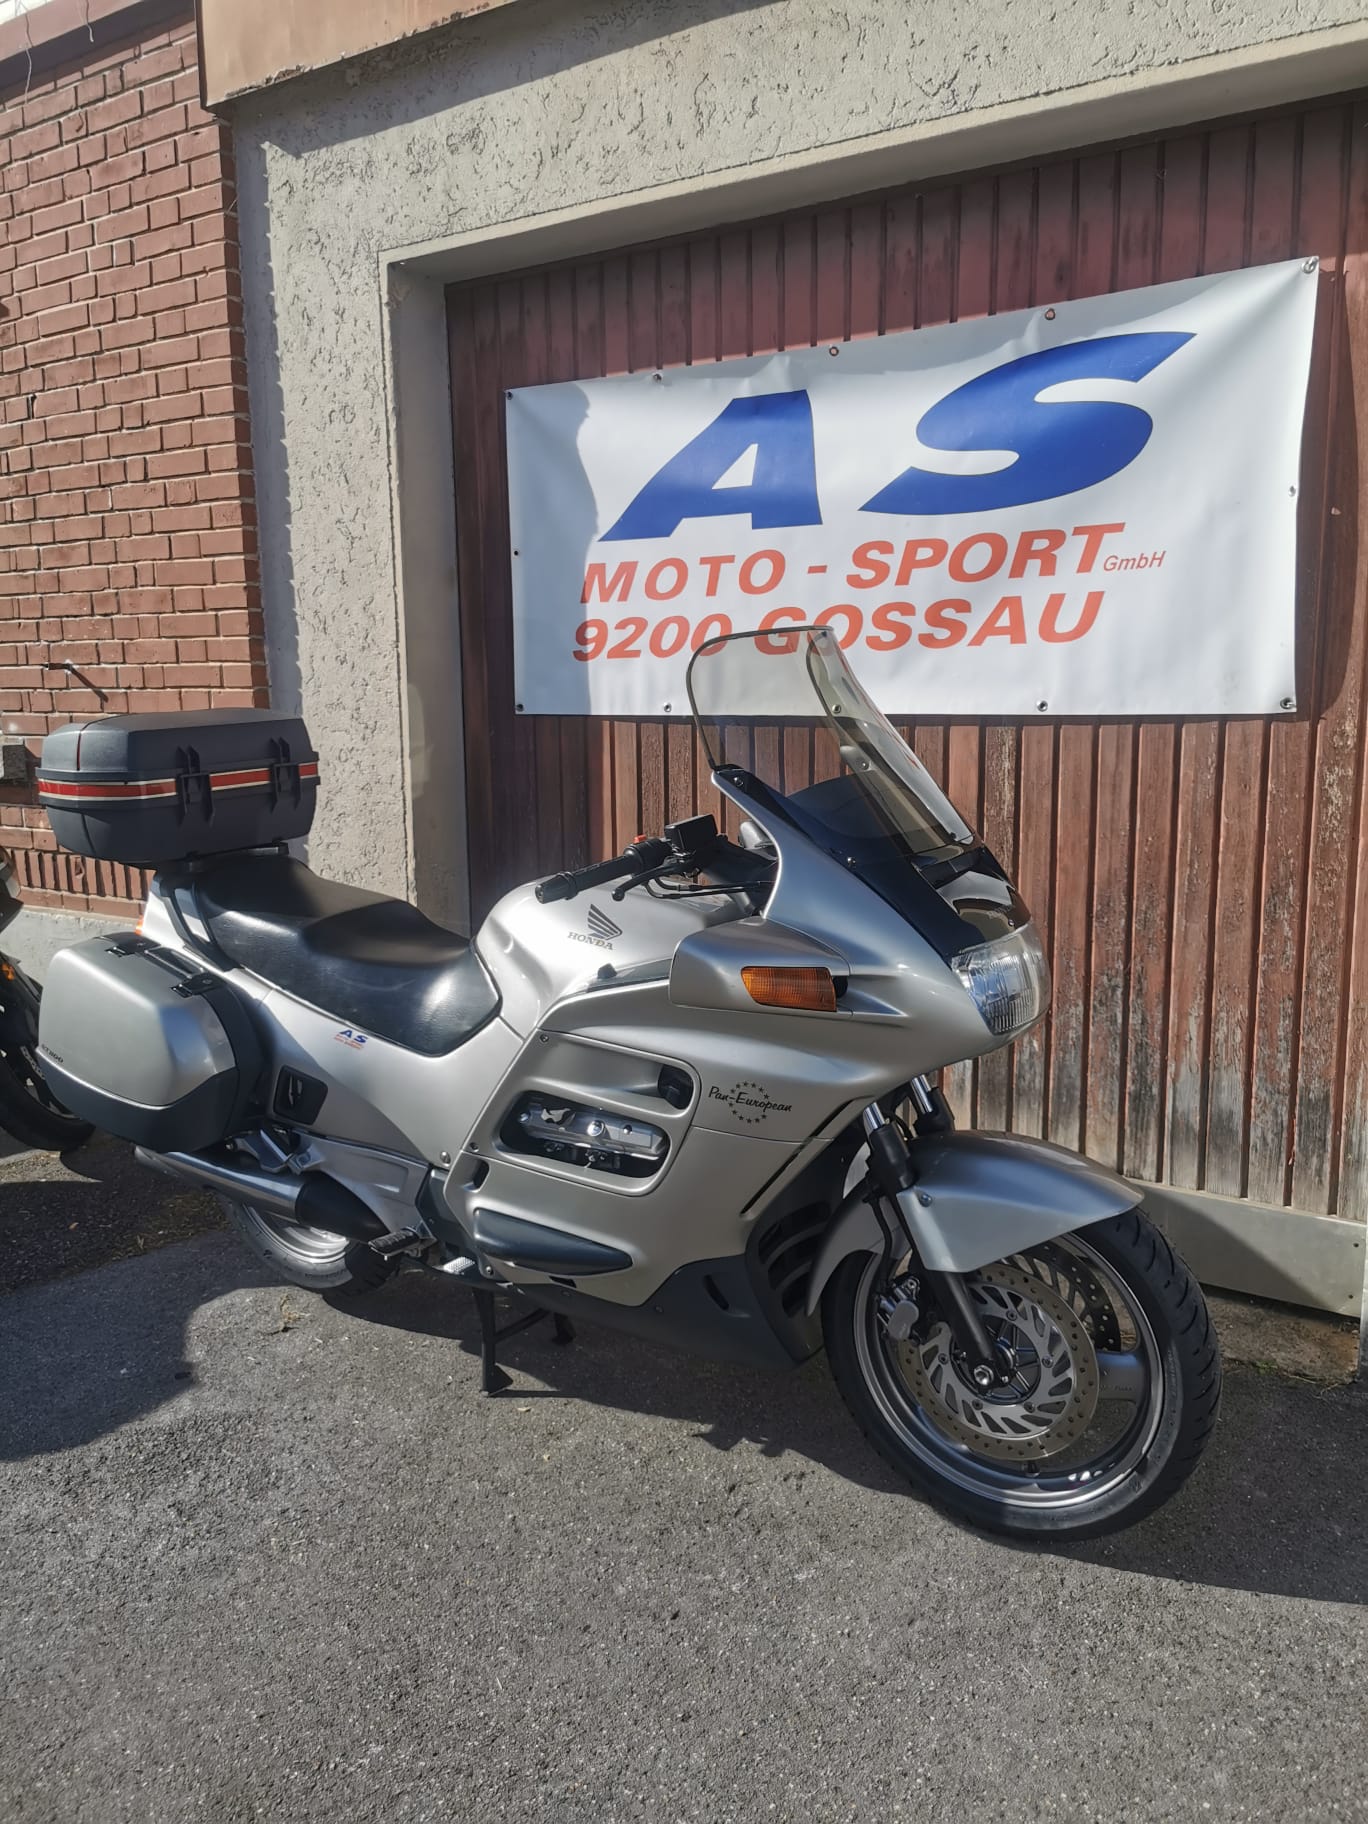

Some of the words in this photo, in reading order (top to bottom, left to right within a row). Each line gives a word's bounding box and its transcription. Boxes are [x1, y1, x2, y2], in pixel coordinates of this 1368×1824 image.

[579, 549, 787, 604] MOTO
[846, 522, 1126, 590] SPORT
[1103, 550, 1167, 573] GmbH
[572, 613, 734, 663] 9200
[753, 590, 1106, 656] GOSSAU
[567, 931, 614, 951] HONDA
[707, 1085, 793, 1113] Pan-European
